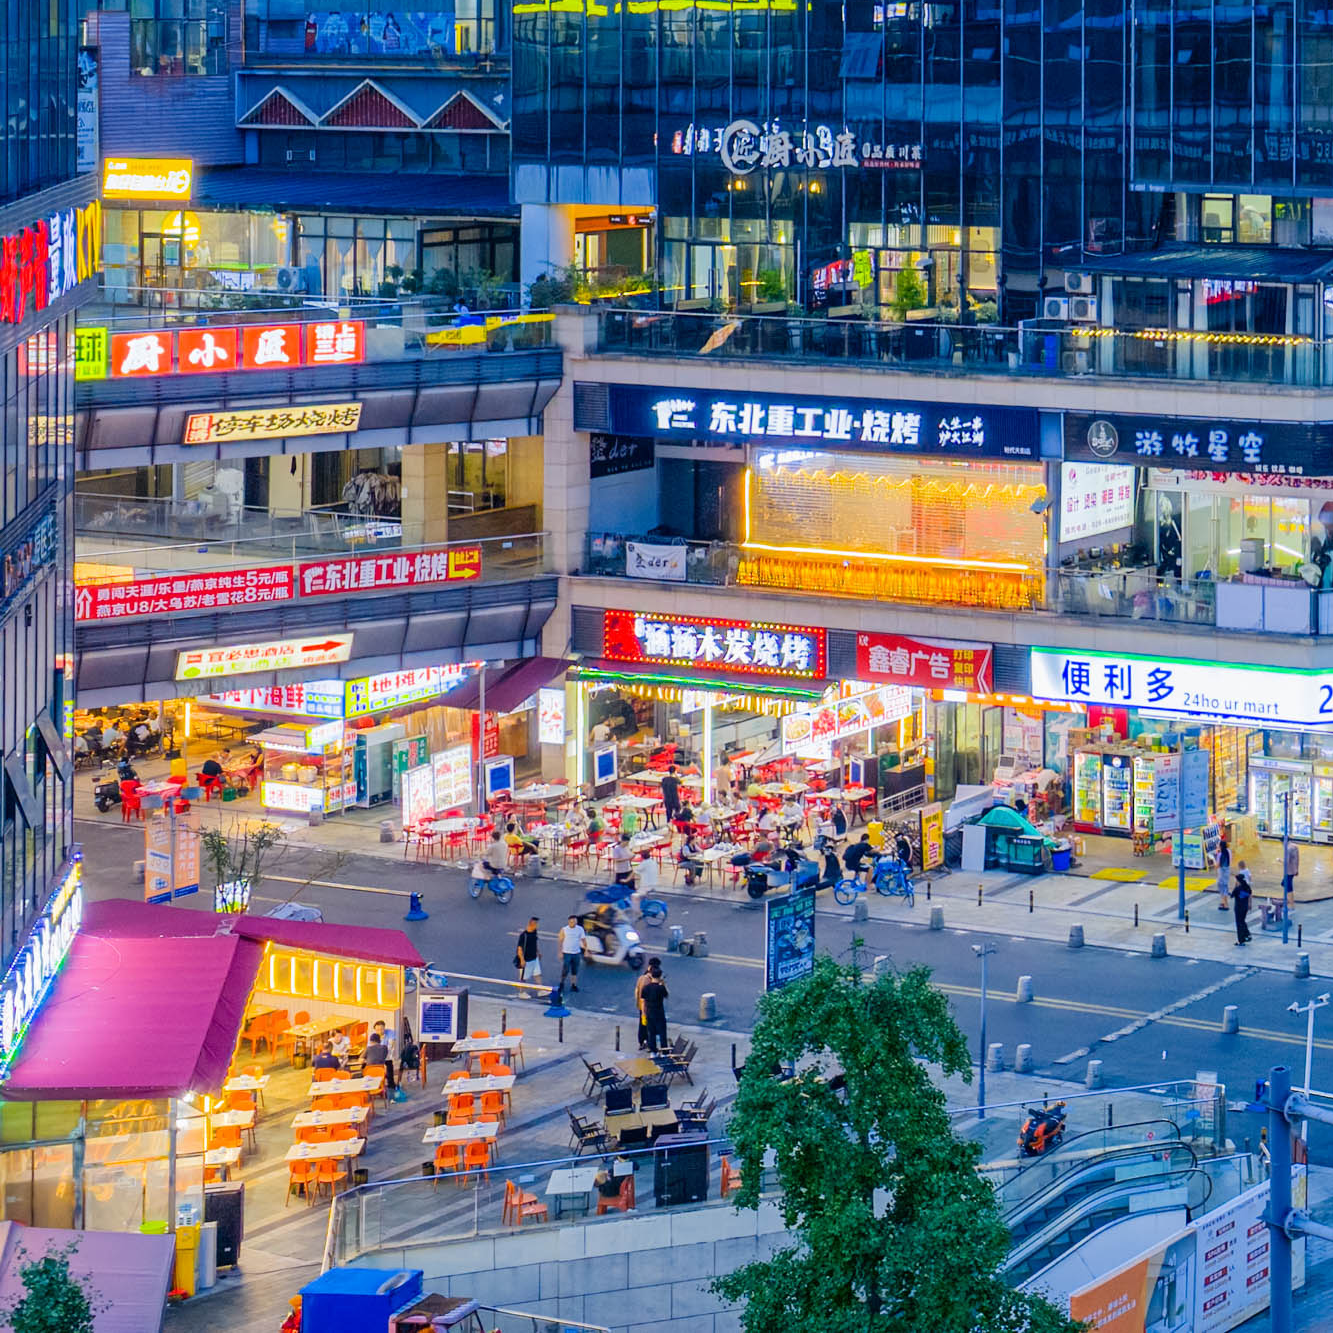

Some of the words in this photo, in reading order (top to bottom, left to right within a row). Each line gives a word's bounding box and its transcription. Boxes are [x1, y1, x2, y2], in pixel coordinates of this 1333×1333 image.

[1134, 428, 1265, 464] 游牧星空
[868, 643, 952, 679] 鑫睿广告
[1061, 658, 1175, 703] 便利多
[1243, 698, 1280, 716] mart
